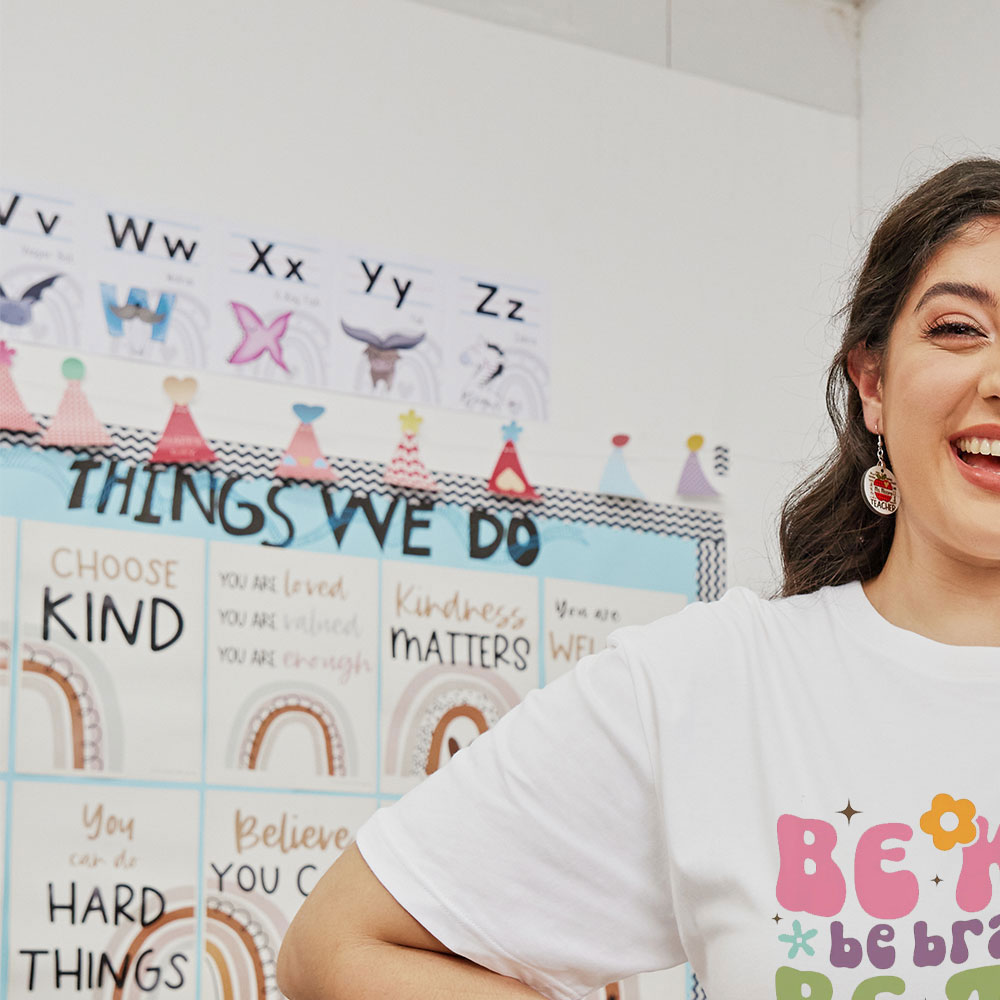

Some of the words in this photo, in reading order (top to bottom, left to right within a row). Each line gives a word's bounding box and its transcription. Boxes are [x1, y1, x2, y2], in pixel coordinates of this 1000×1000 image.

[249, 240, 274, 276] X
[360, 260, 384, 293] Y
[476, 283, 498, 317] Z
[67, 459, 296, 547] THINGS
[320, 486, 431, 557] WE
[469, 509, 541, 566] DO
[51, 547, 179, 589] CHOOSE
[219, 572, 248, 588] YOU
[252, 574, 277, 593] ARE
[284, 569, 347, 600] loved
[43, 586, 185, 652] KIND
[219, 609, 248, 627] YOU
[252, 611, 276, 631] ARE
[396, 580, 526, 630] Kindness
[217, 647, 248, 665] YOU
[251, 649, 276, 669] ARE
[283, 651, 372, 684] enough
[83, 803, 135, 840] You
[234, 809, 350, 854] Believe
[70, 853, 104, 868] can
[114, 850, 138, 870] do
[211, 862, 279, 893] YOU
[296, 864, 317, 897] C
[776, 813, 919, 919] BE
[48, 881, 165, 927] HARD
[829, 920, 896, 969] be
[19, 949, 188, 992] THINGS
